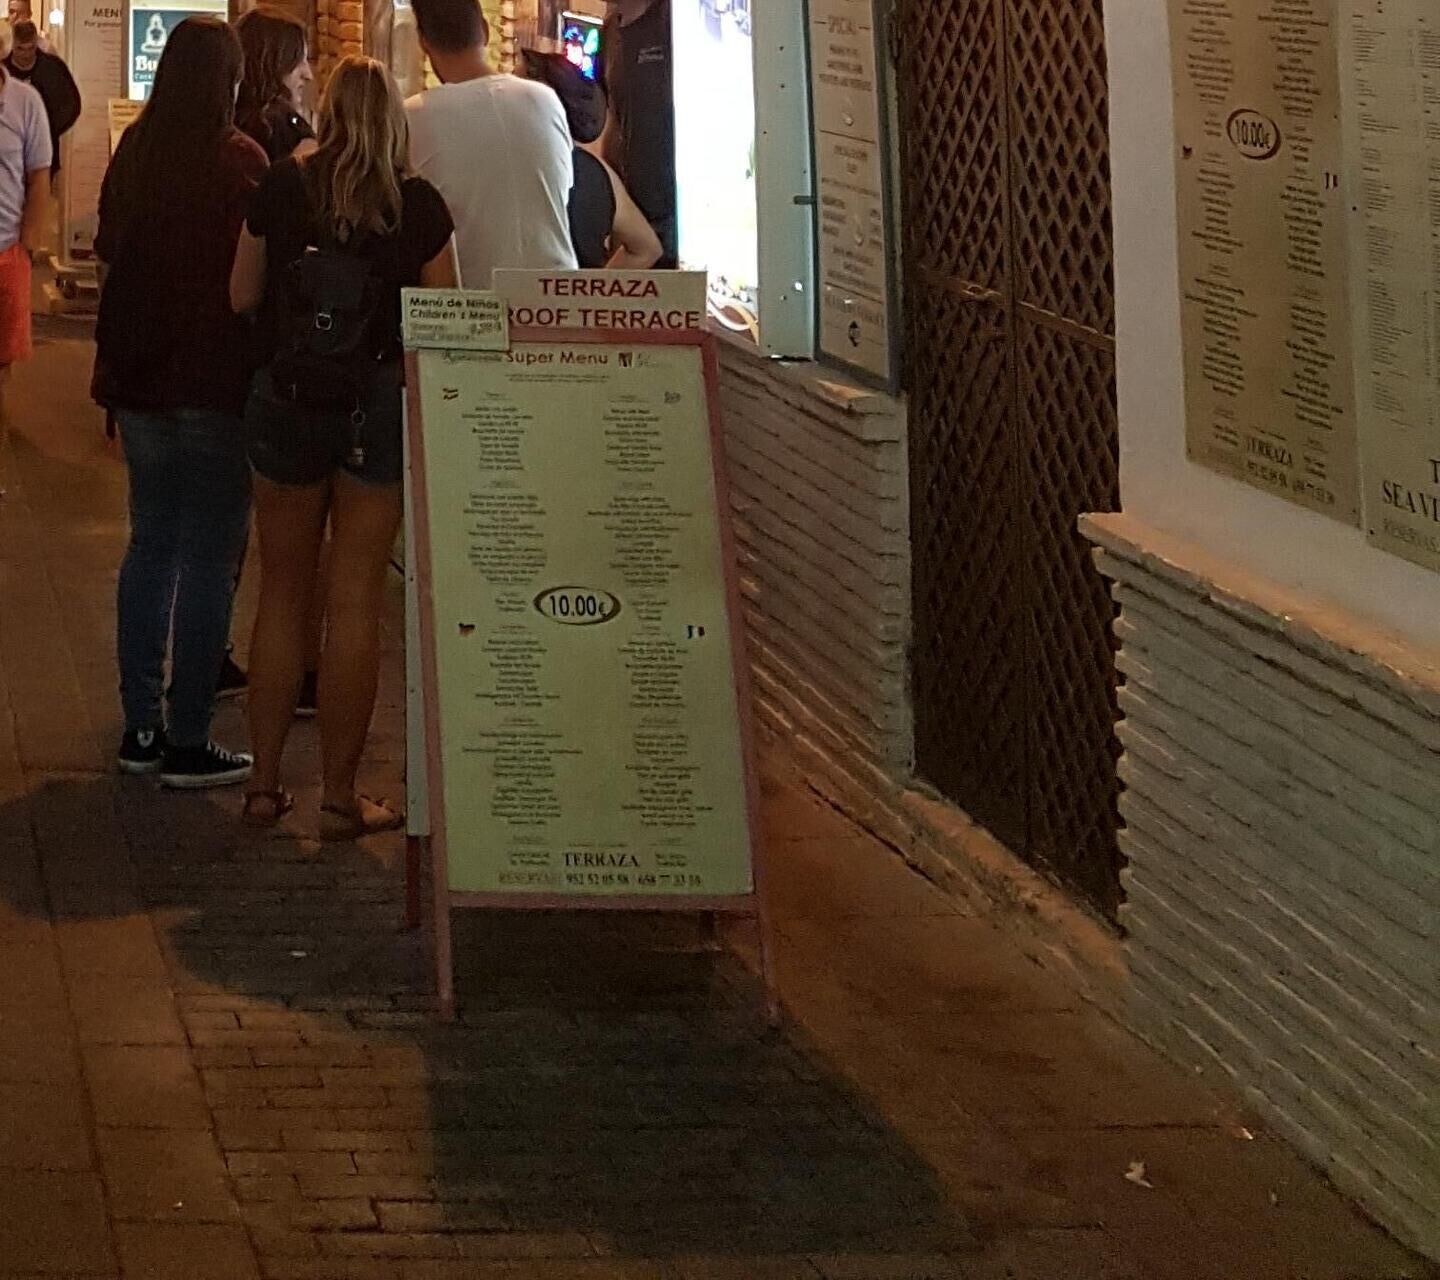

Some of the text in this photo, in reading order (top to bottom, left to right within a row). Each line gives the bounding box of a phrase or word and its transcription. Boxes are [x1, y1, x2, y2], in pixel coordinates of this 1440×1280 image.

[538, 278, 659, 297] TERRAZA
[447, 298, 462, 308] de
[577, 308, 700, 328] TERRACE
[507, 351, 554, 366] Super
[560, 351, 608, 365] Menu
[563, 852, 640, 868] TERRAZA
